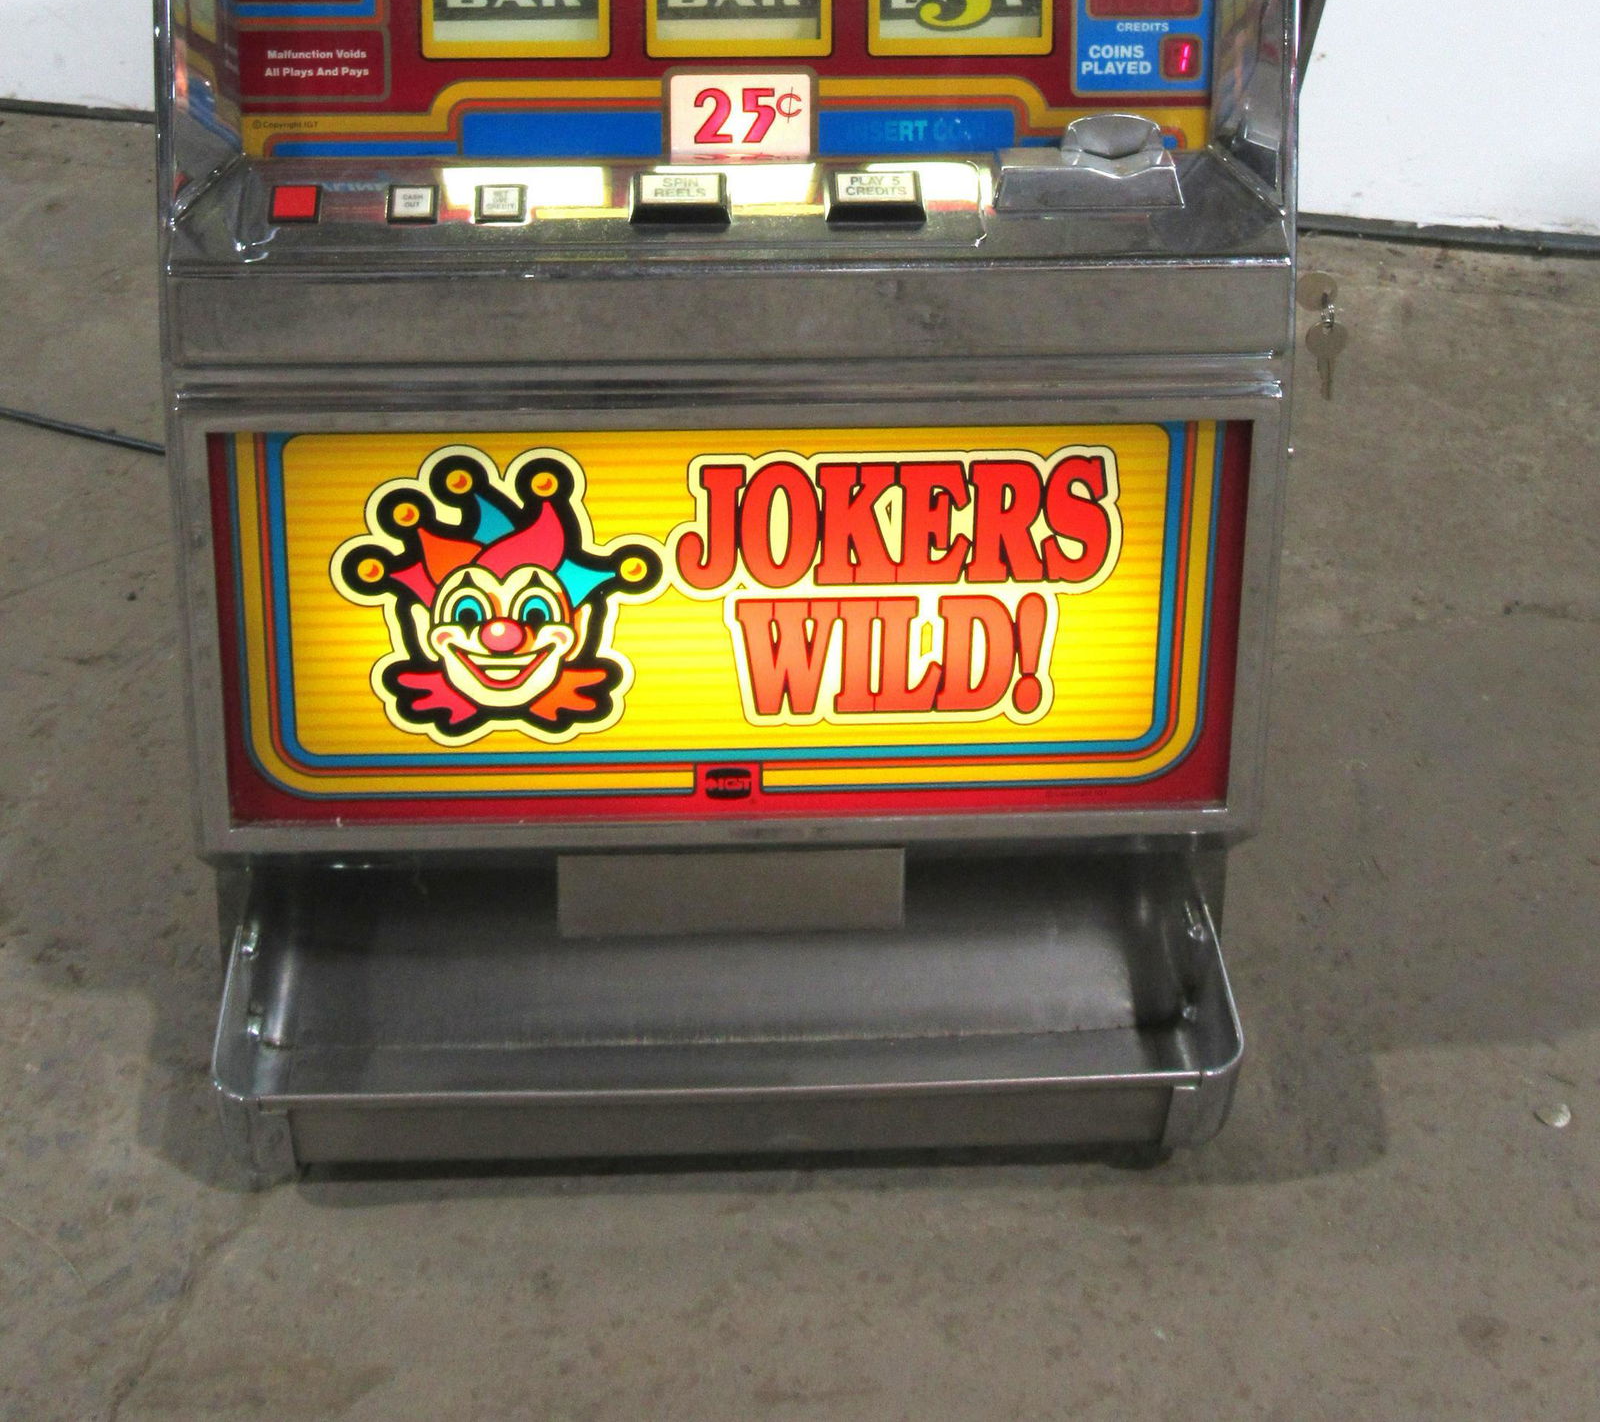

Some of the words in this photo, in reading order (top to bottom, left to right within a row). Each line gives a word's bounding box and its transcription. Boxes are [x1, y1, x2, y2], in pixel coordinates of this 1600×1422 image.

[1116, 22, 1170, 33] CREDITS
[267, 50, 333, 59] Malfunction
[336, 49, 367, 59] Voids
[1088, 45, 1145, 59] COINS
[1180, 43, 1191, 73] 1
[264, 67, 280, 77] All
[283, 67, 314, 78] Plays
[316, 67, 338, 76] And
[341, 67, 369, 78] Pays
[1081, 61, 1152, 75] PLAYED
[694, 86, 802, 144] 25¢
[262, 121, 302, 130] Copyright
[662, 178, 699, 188] SPIN
[850, 176, 883, 186] PLAY
[891, 176, 901, 186] 5
[654, 188, 707, 197] REELS
[845, 186, 908, 196] CREDITS
[676, 455, 1111, 590] JOKERS
[736, 592, 1048, 715] WILD!
